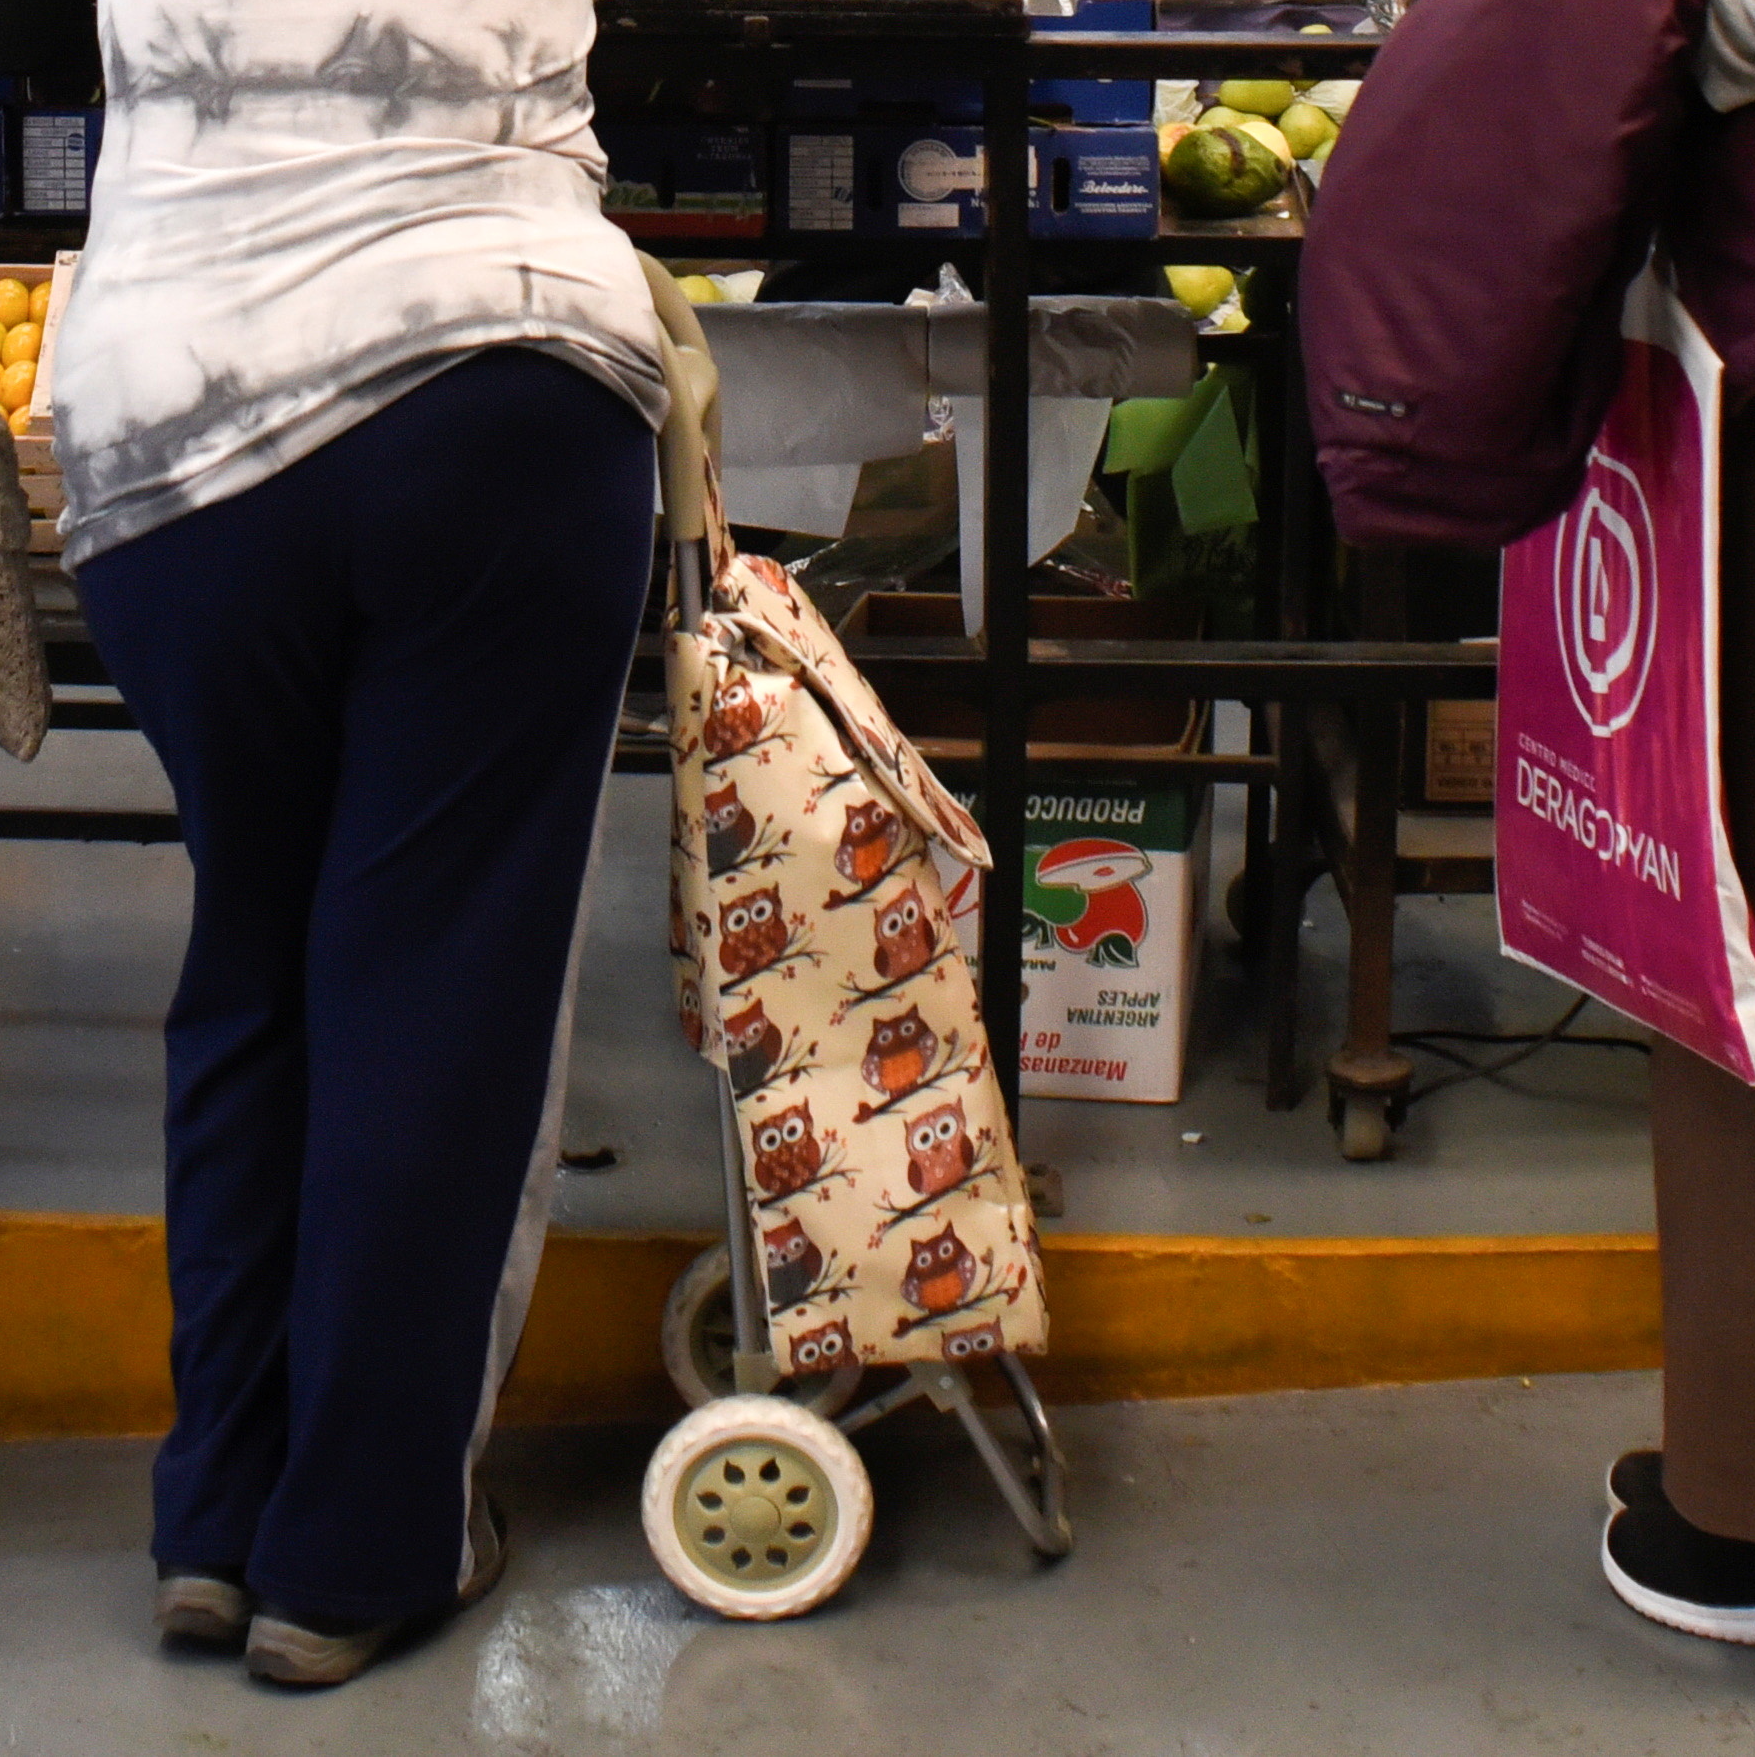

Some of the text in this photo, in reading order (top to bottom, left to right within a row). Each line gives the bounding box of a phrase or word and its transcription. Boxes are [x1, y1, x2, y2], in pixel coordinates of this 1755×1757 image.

[1097, 989, 1162, 1009] APPLES
[1066, 1007, 1162, 1028] ARGENTINA
[1019, 1056, 1128, 1083] Manzanas
